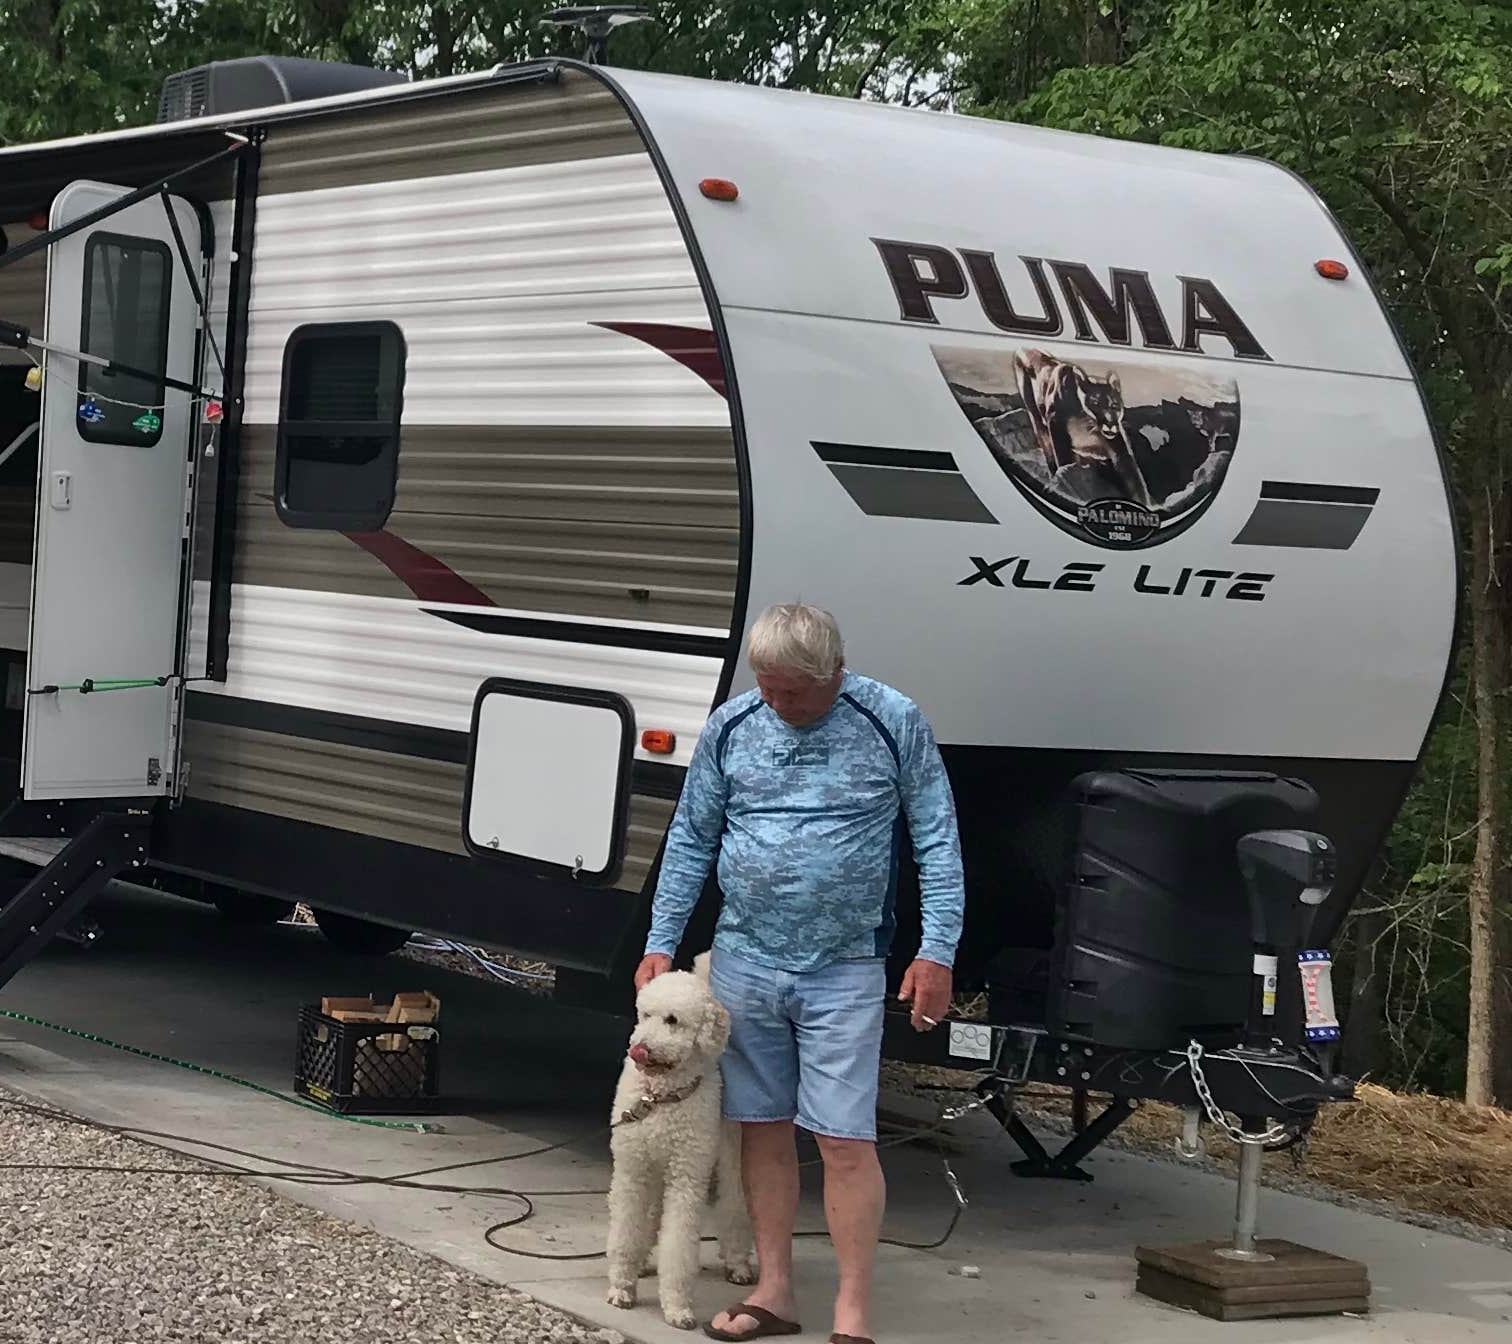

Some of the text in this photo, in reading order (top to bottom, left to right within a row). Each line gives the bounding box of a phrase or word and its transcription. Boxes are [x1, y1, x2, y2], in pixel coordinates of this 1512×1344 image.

[869, 236, 1275, 362] PUMA
[1077, 507, 1160, 528] PALOMINO
[1108, 531, 1132, 542] 1968
[956, 555, 1275, 602] XLE LITE
